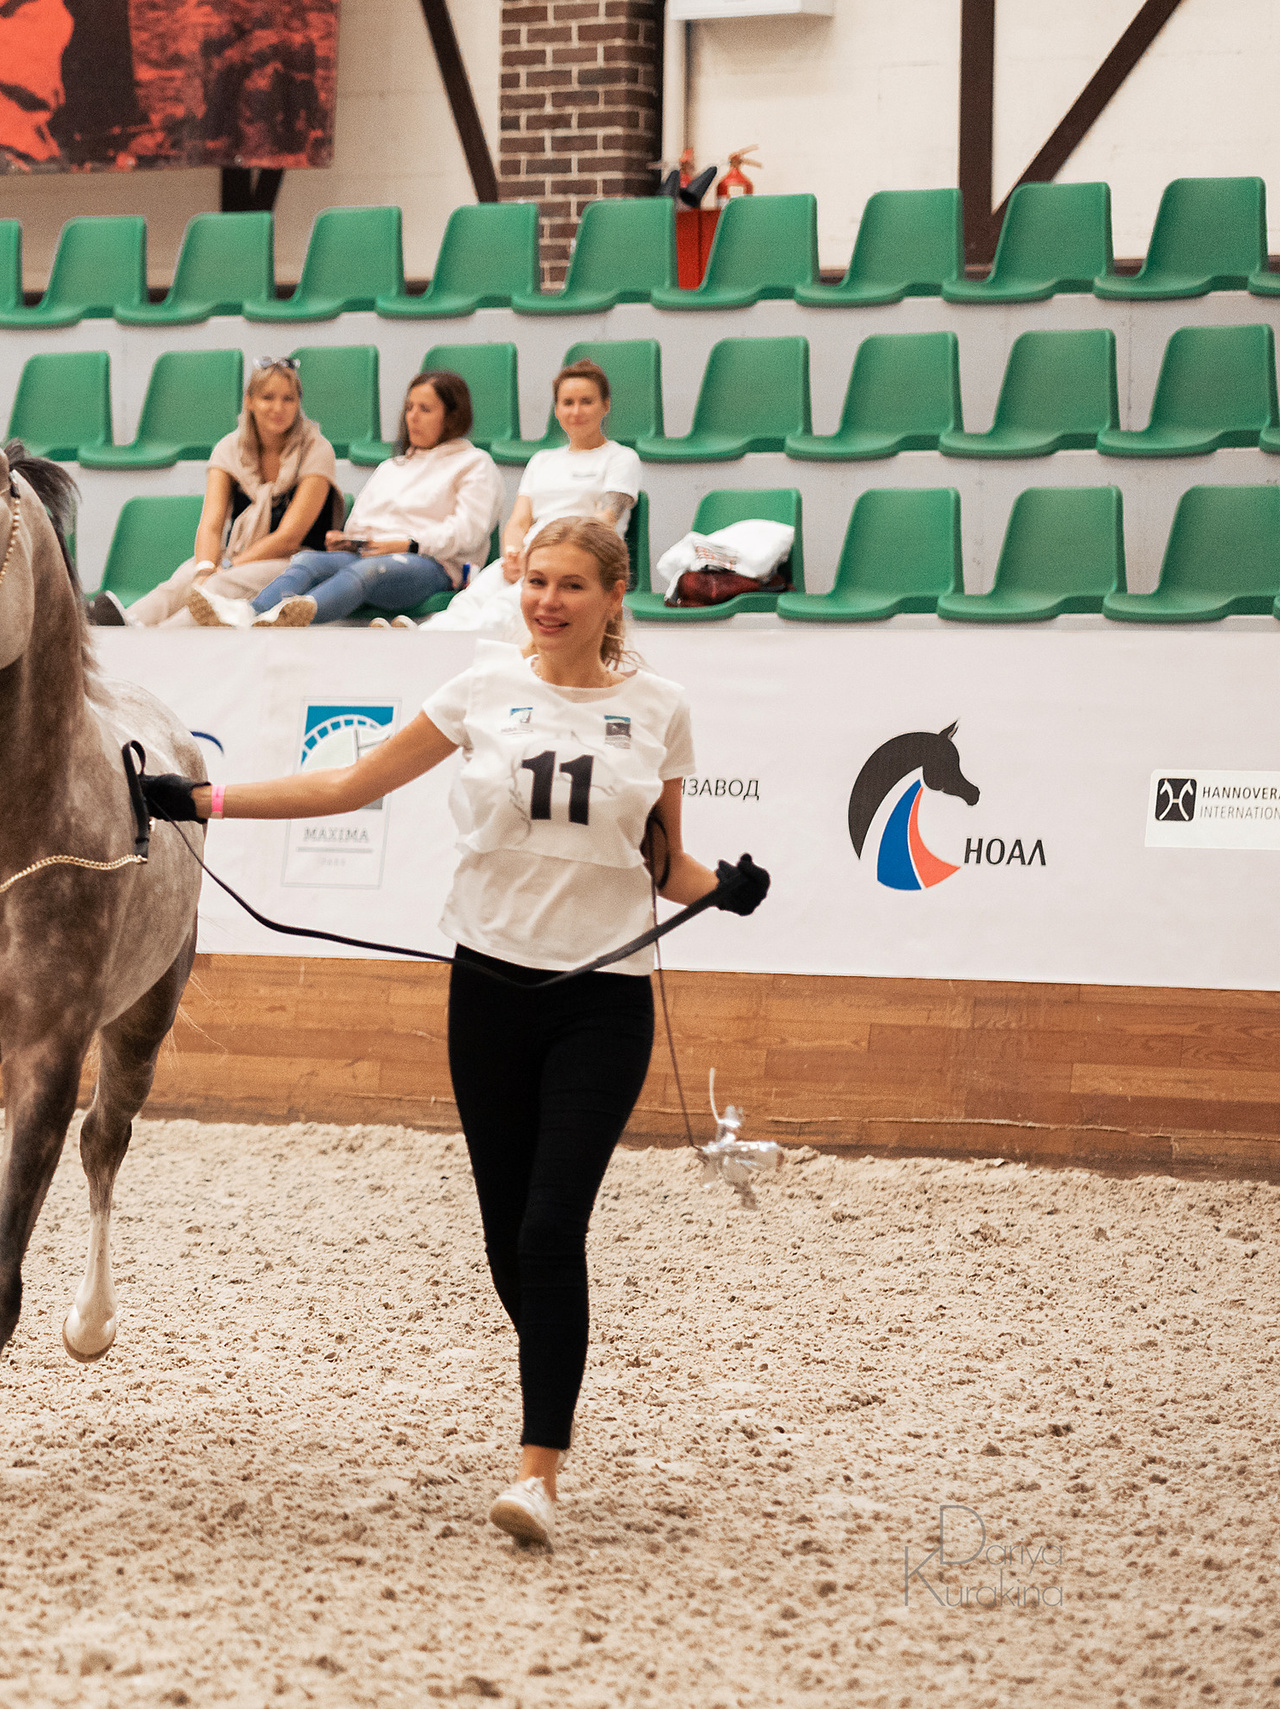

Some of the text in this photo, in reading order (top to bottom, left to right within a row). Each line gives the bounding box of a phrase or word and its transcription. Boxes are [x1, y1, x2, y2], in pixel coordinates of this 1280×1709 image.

[521, 750, 594, 826] 11
[1202, 786, 1280, 800] HANNOVER
[303, 827, 369, 842] MAXIMA
